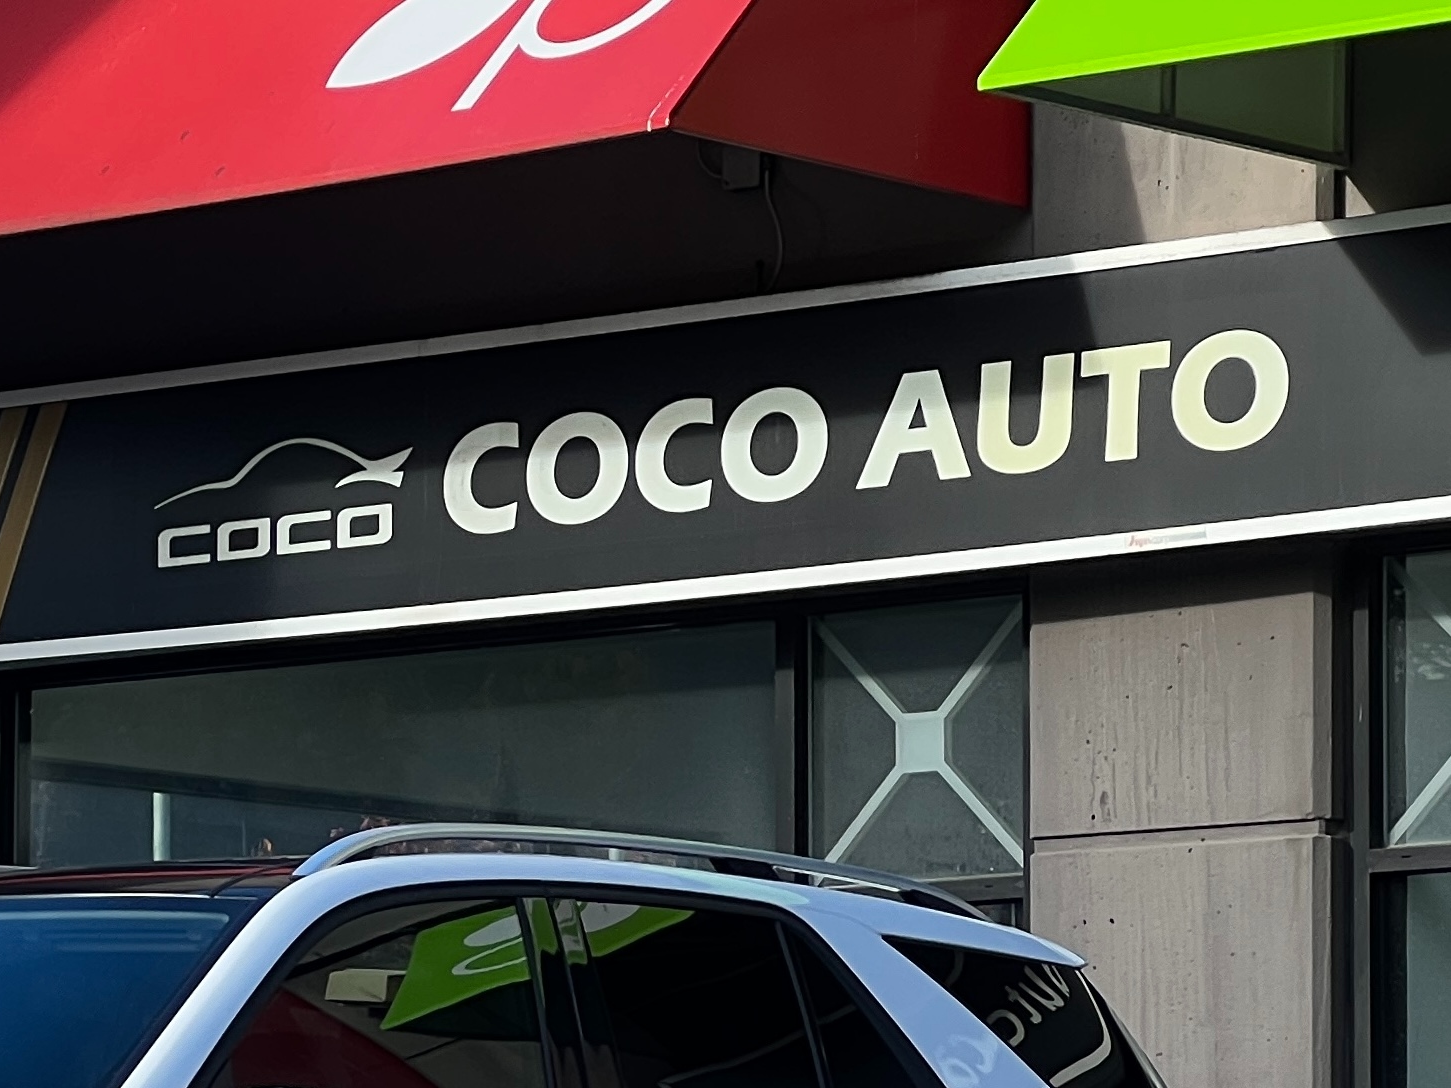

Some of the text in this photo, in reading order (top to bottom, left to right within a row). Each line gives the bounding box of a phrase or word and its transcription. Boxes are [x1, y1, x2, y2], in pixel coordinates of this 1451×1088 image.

[443, 329, 1290, 535] COCO AUTO
[157, 502, 393, 568] COCO
